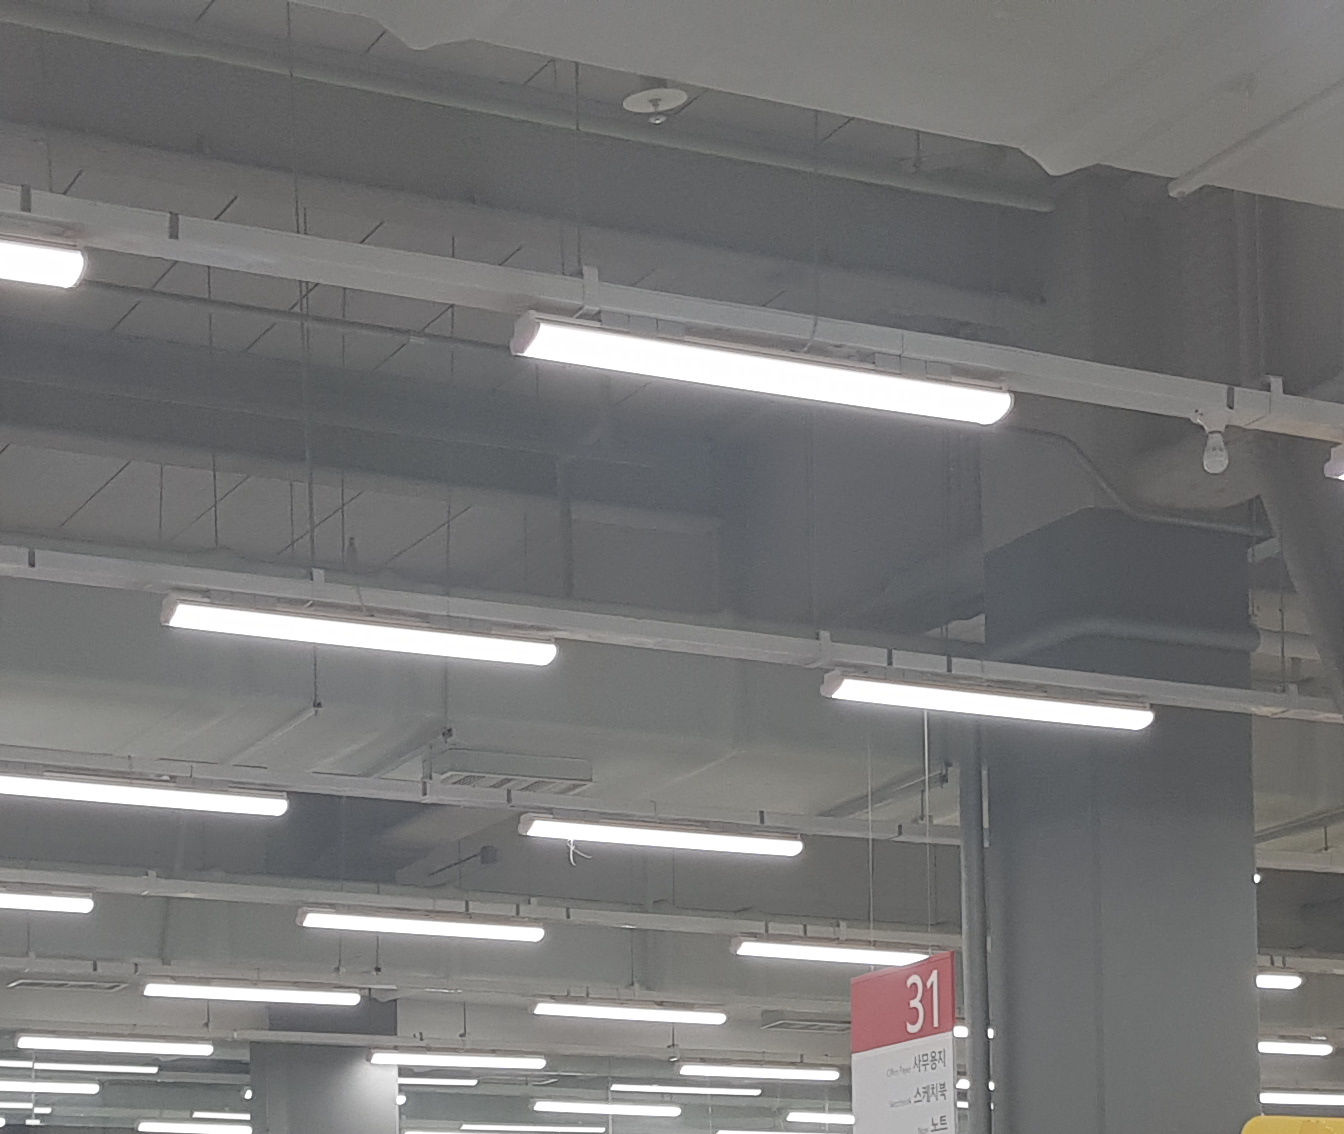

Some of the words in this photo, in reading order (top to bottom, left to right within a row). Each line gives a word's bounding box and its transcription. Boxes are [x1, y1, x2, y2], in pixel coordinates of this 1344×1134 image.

[906, 969, 939, 1033] 31
[913, 1048, 946, 1072] 사무용지
[914, 1081, 947, 1103] 스케치북
[931, 1115, 948, 1132] 노트
